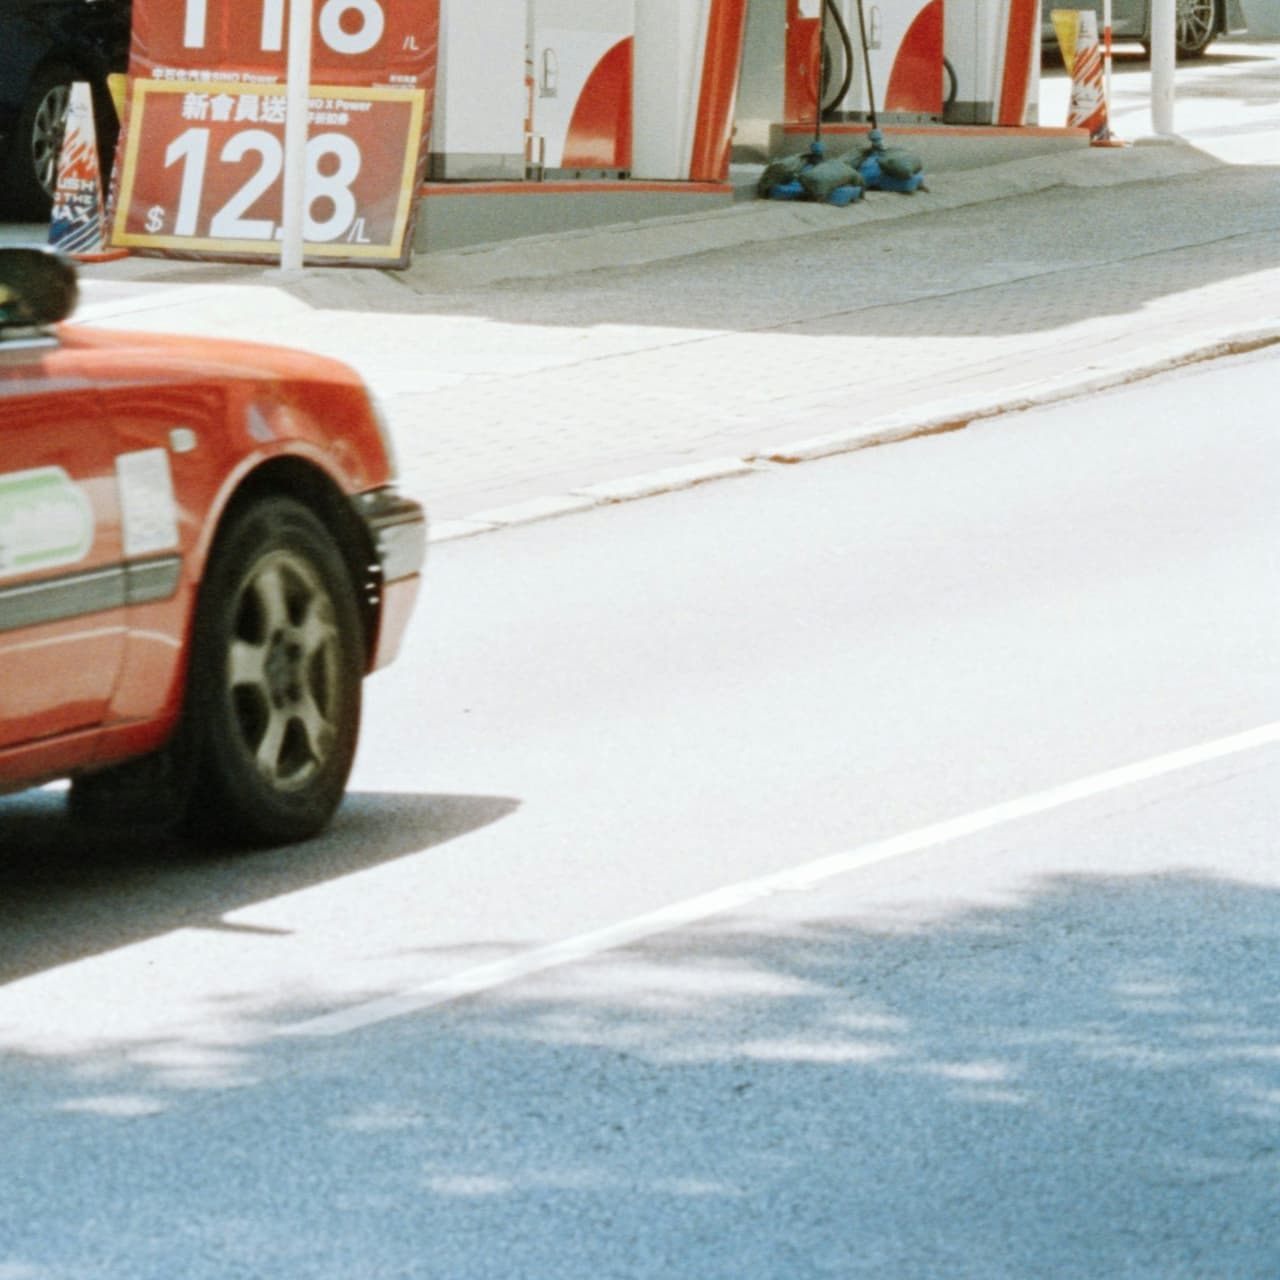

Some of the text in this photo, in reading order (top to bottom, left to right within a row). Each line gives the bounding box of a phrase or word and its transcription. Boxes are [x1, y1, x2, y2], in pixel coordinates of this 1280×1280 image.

[182, 91, 288, 123] 新會員送
[335, 100, 372, 113] Power
[145, 205, 166, 233] $
